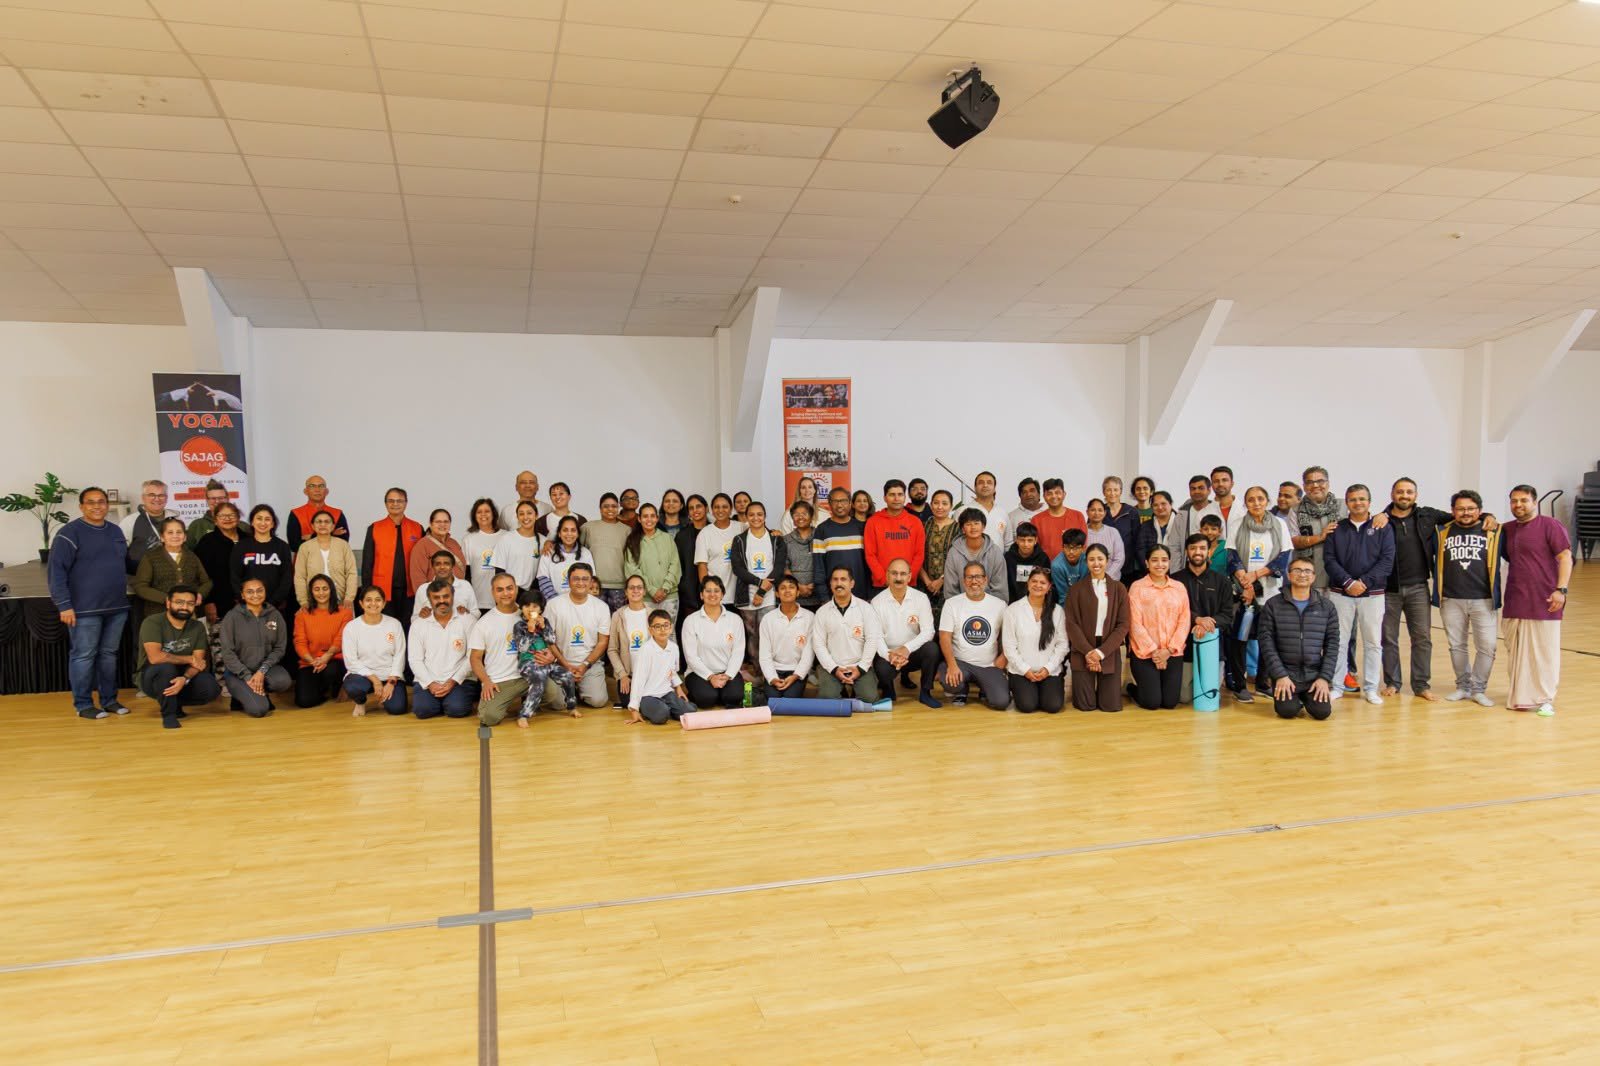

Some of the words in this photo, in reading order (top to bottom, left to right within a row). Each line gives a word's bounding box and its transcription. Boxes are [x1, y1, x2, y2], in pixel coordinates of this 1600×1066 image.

[168, 413, 234, 428] YOGA
[183, 452, 224, 462] SAJAG
[243, 552, 282, 566] FILA
[1450, 547, 1482, 561] ROCK
